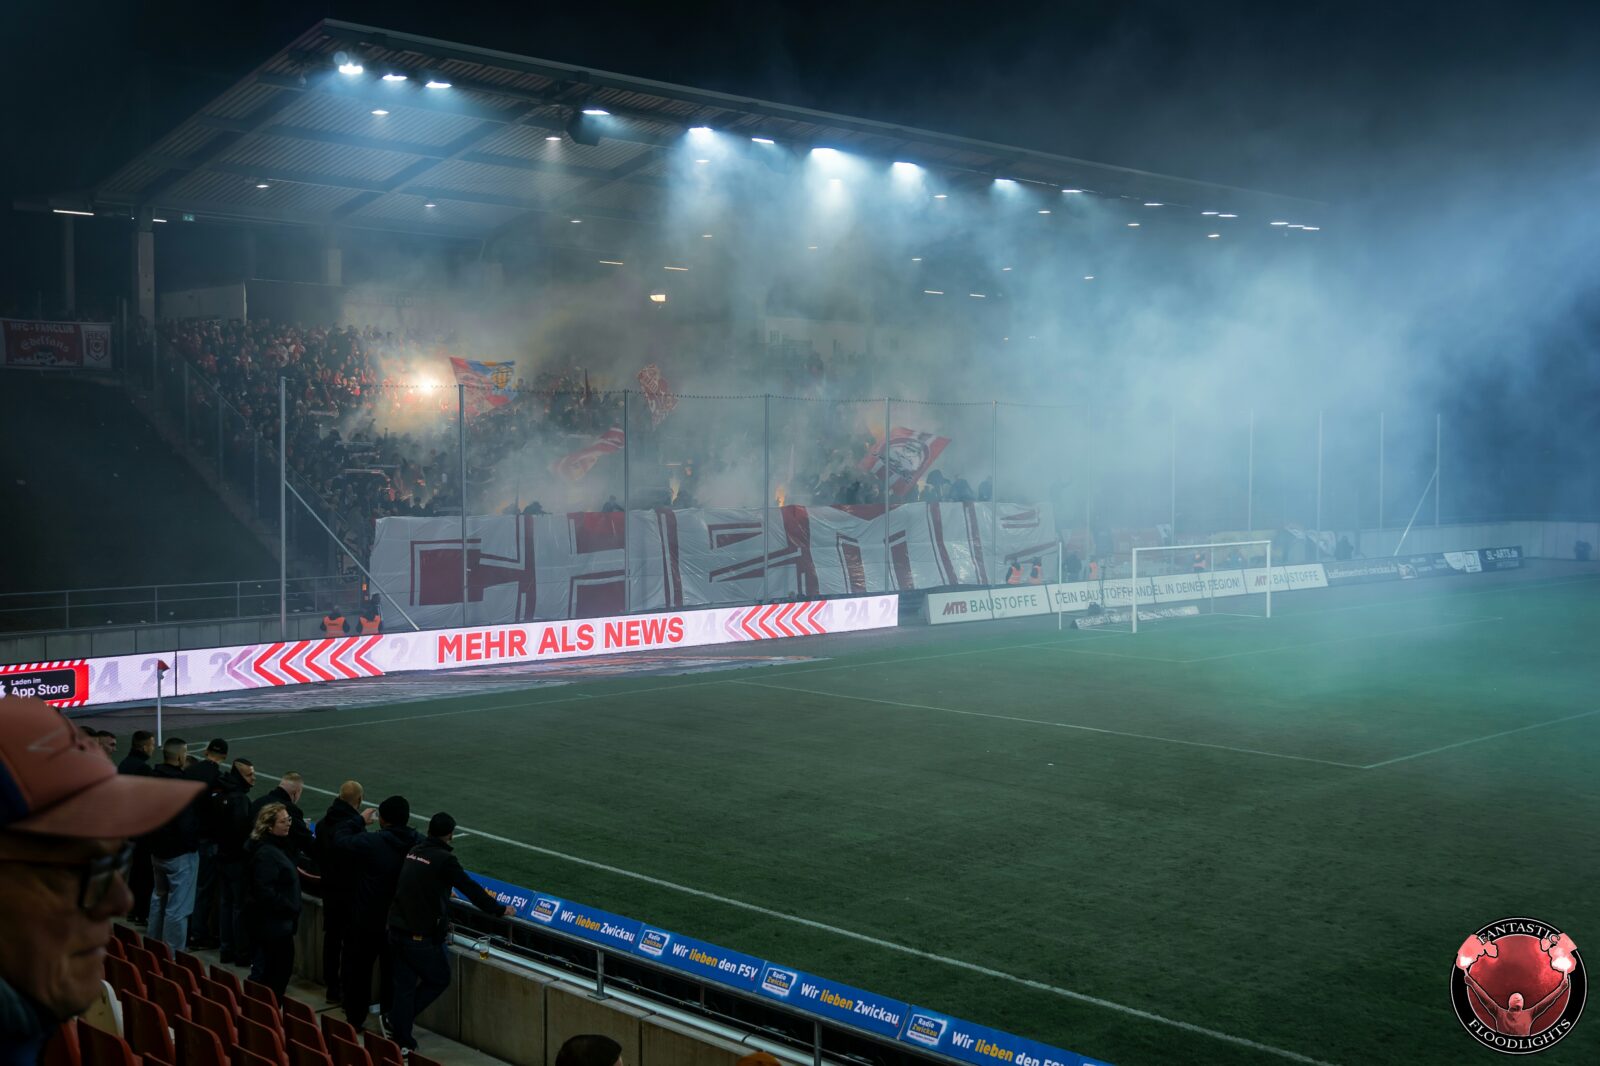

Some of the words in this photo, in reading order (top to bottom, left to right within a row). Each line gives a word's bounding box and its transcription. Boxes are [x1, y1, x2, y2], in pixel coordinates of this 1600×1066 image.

[1272, 570, 1319, 585] BAUSTOFFE
[942, 601, 968, 615] MTB
[970, 594, 1037, 613] BAUSTOFFE
[438, 629, 528, 664] MEHR
[537, 623, 595, 655] ALS
[604, 616, 684, 649] NEWS
[11, 679, 32, 687] Laden
[11, 686, 36, 698] App
[38, 684, 70, 696] Store
[497, 891, 511, 904] den
[511, 895, 528, 908] FSV
[560, 910, 576, 923] Wir
[575, 914, 601, 931] lieben
[600, 922, 636, 942] Zwickau
[672, 943, 689, 957] Wir
[688, 948, 718, 967] lieben
[718, 958, 736, 973] den
[737, 963, 758, 978] FSV
[767, 977, 789, 989] Zwickau
[772, 971, 787, 981] Radio
[800, 983, 819, 999] Wir
[819, 989, 854, 1010] lieben
[854, 1000, 900, 1025] Zwickau
[911, 1023, 939, 1038] Zwickau
[917, 1017, 935, 1028] Radio
[951, 1031, 974, 1049] Wir
[974, 1038, 1014, 1062] lieben
[1015, 1052, 1040, 1066] den
